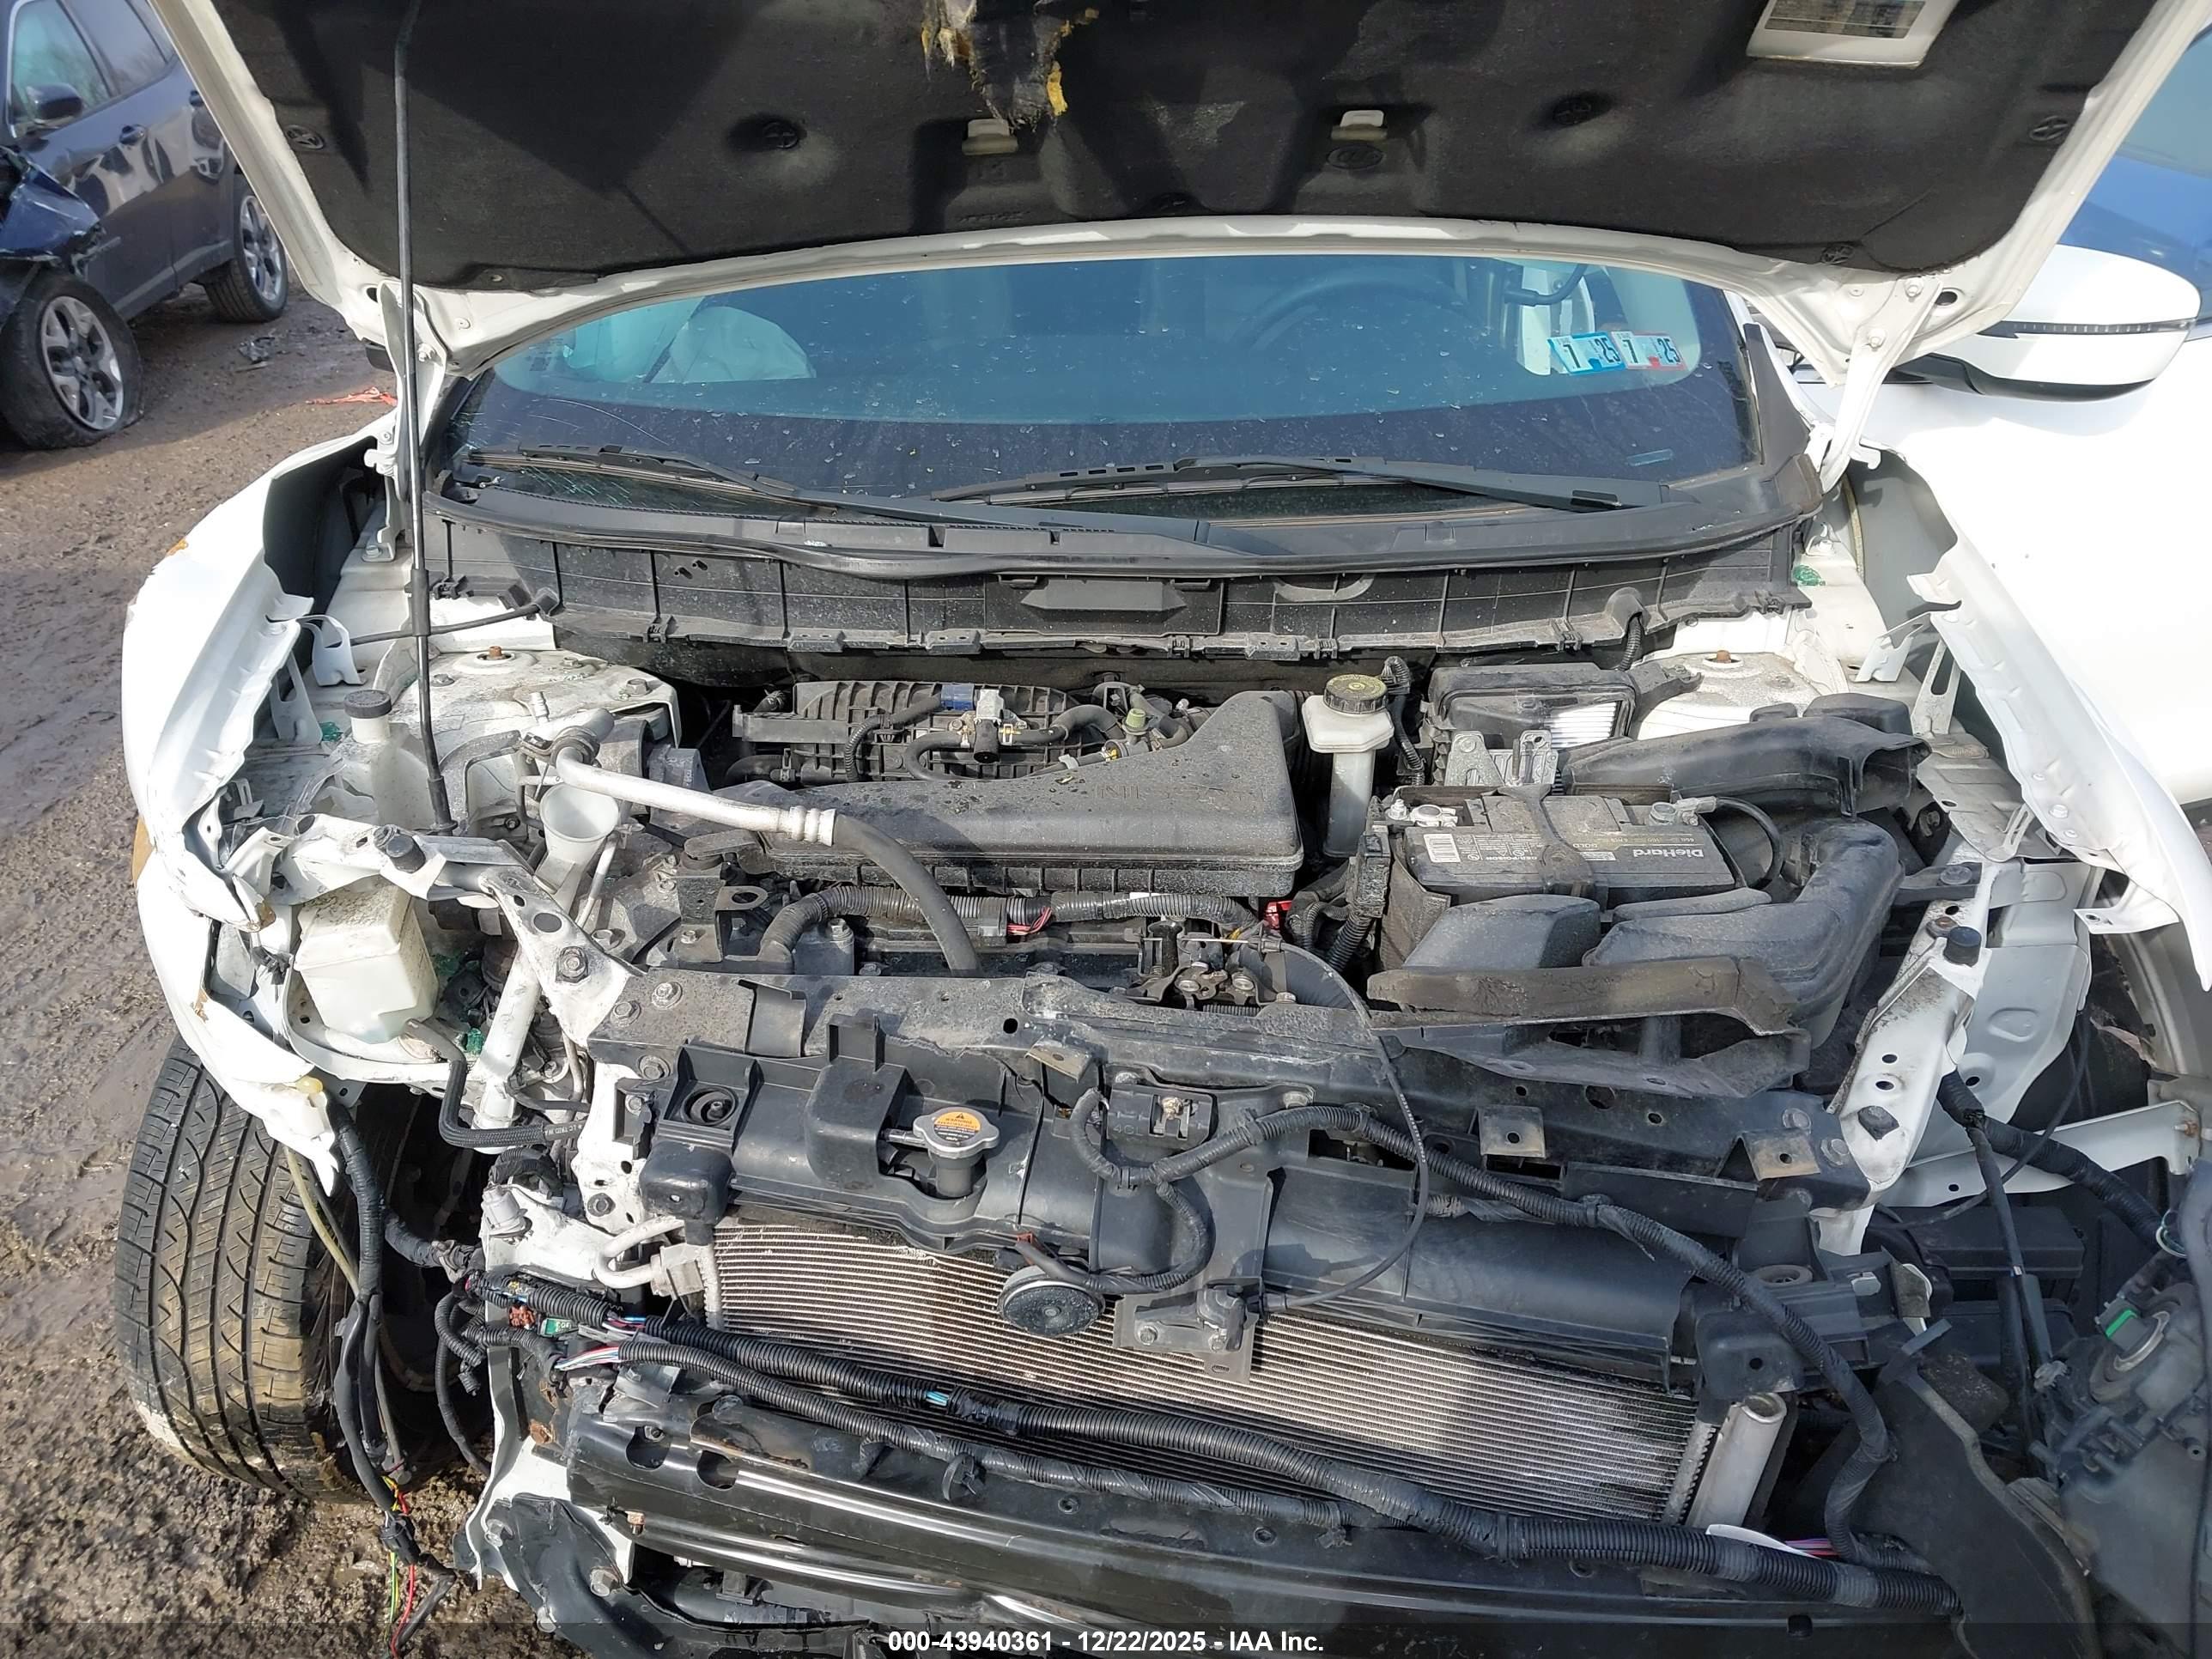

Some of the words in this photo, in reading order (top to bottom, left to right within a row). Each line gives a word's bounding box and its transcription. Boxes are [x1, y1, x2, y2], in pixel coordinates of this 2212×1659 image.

[1563, 343, 1581, 368] 7
[1595, 337, 1621, 363] 25
[1623, 339, 1639, 364] 7
[1657, 337, 1680, 363] 25
[1632, 848, 1705, 858] DieHard
